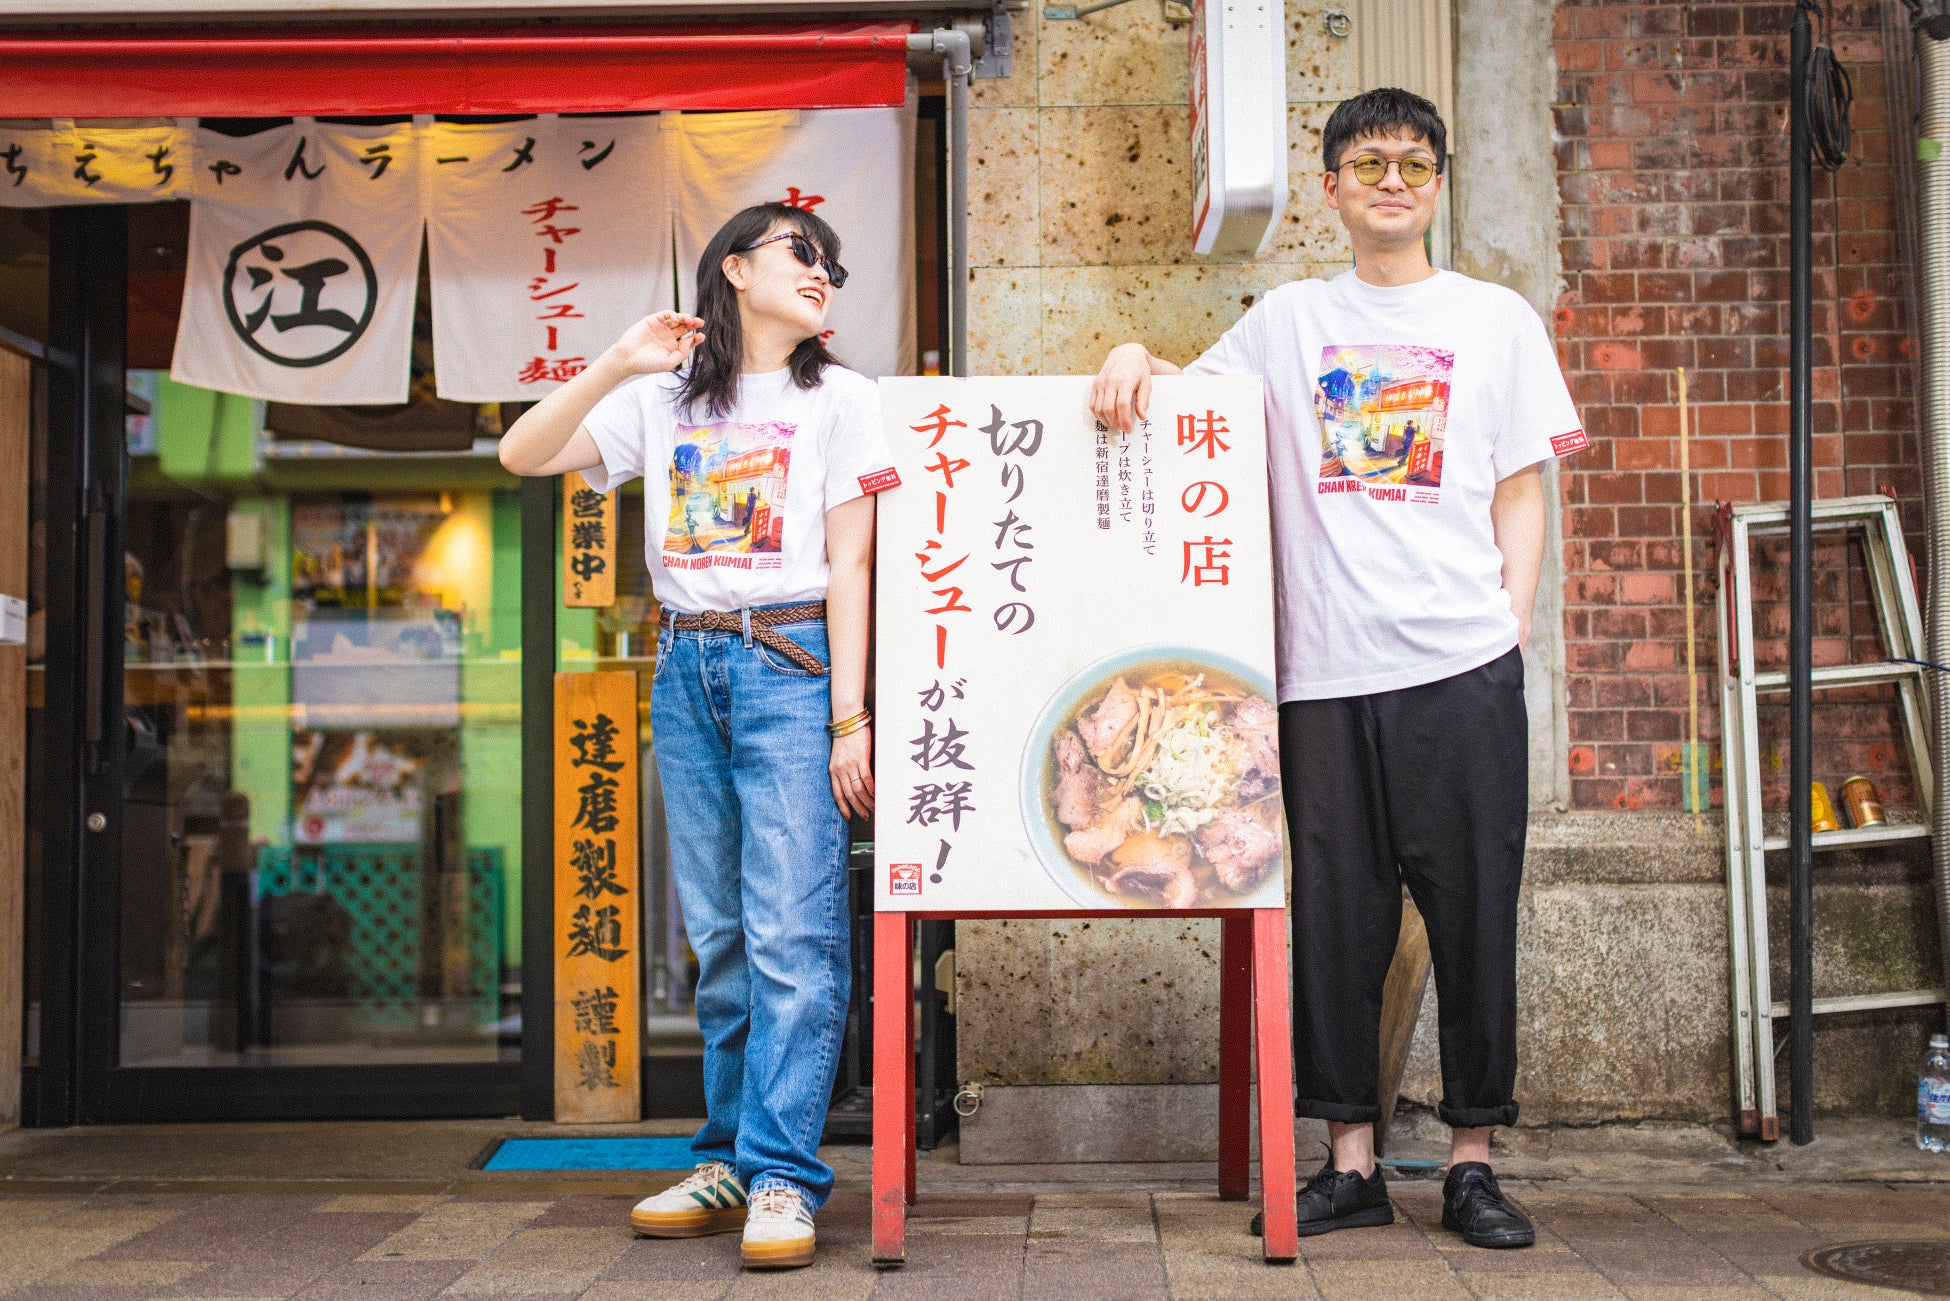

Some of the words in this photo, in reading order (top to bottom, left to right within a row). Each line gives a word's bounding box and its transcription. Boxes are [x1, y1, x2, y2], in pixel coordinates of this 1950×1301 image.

[1, 137, 615, 187] ちえちゃんラーメン
[246, 241, 361, 334] 江
[518, 197, 588, 385] チャーシュー麺
[978, 403, 1044, 636] 切りたての
[1118, 430, 1132, 523] ープは炊き立て
[1140, 419, 1156, 556] チャーシューは切り立て
[1177, 410, 1233, 586] 味の店
[1317, 480, 1345, 494] CHAN
[1368, 487, 1407, 501] KUMIAI
[571, 489, 607, 581] 営業中
[662, 555, 688, 569] CHAN
[714, 555, 753, 570] KUMIAI
[566, 713, 630, 963] 達磨製麺
